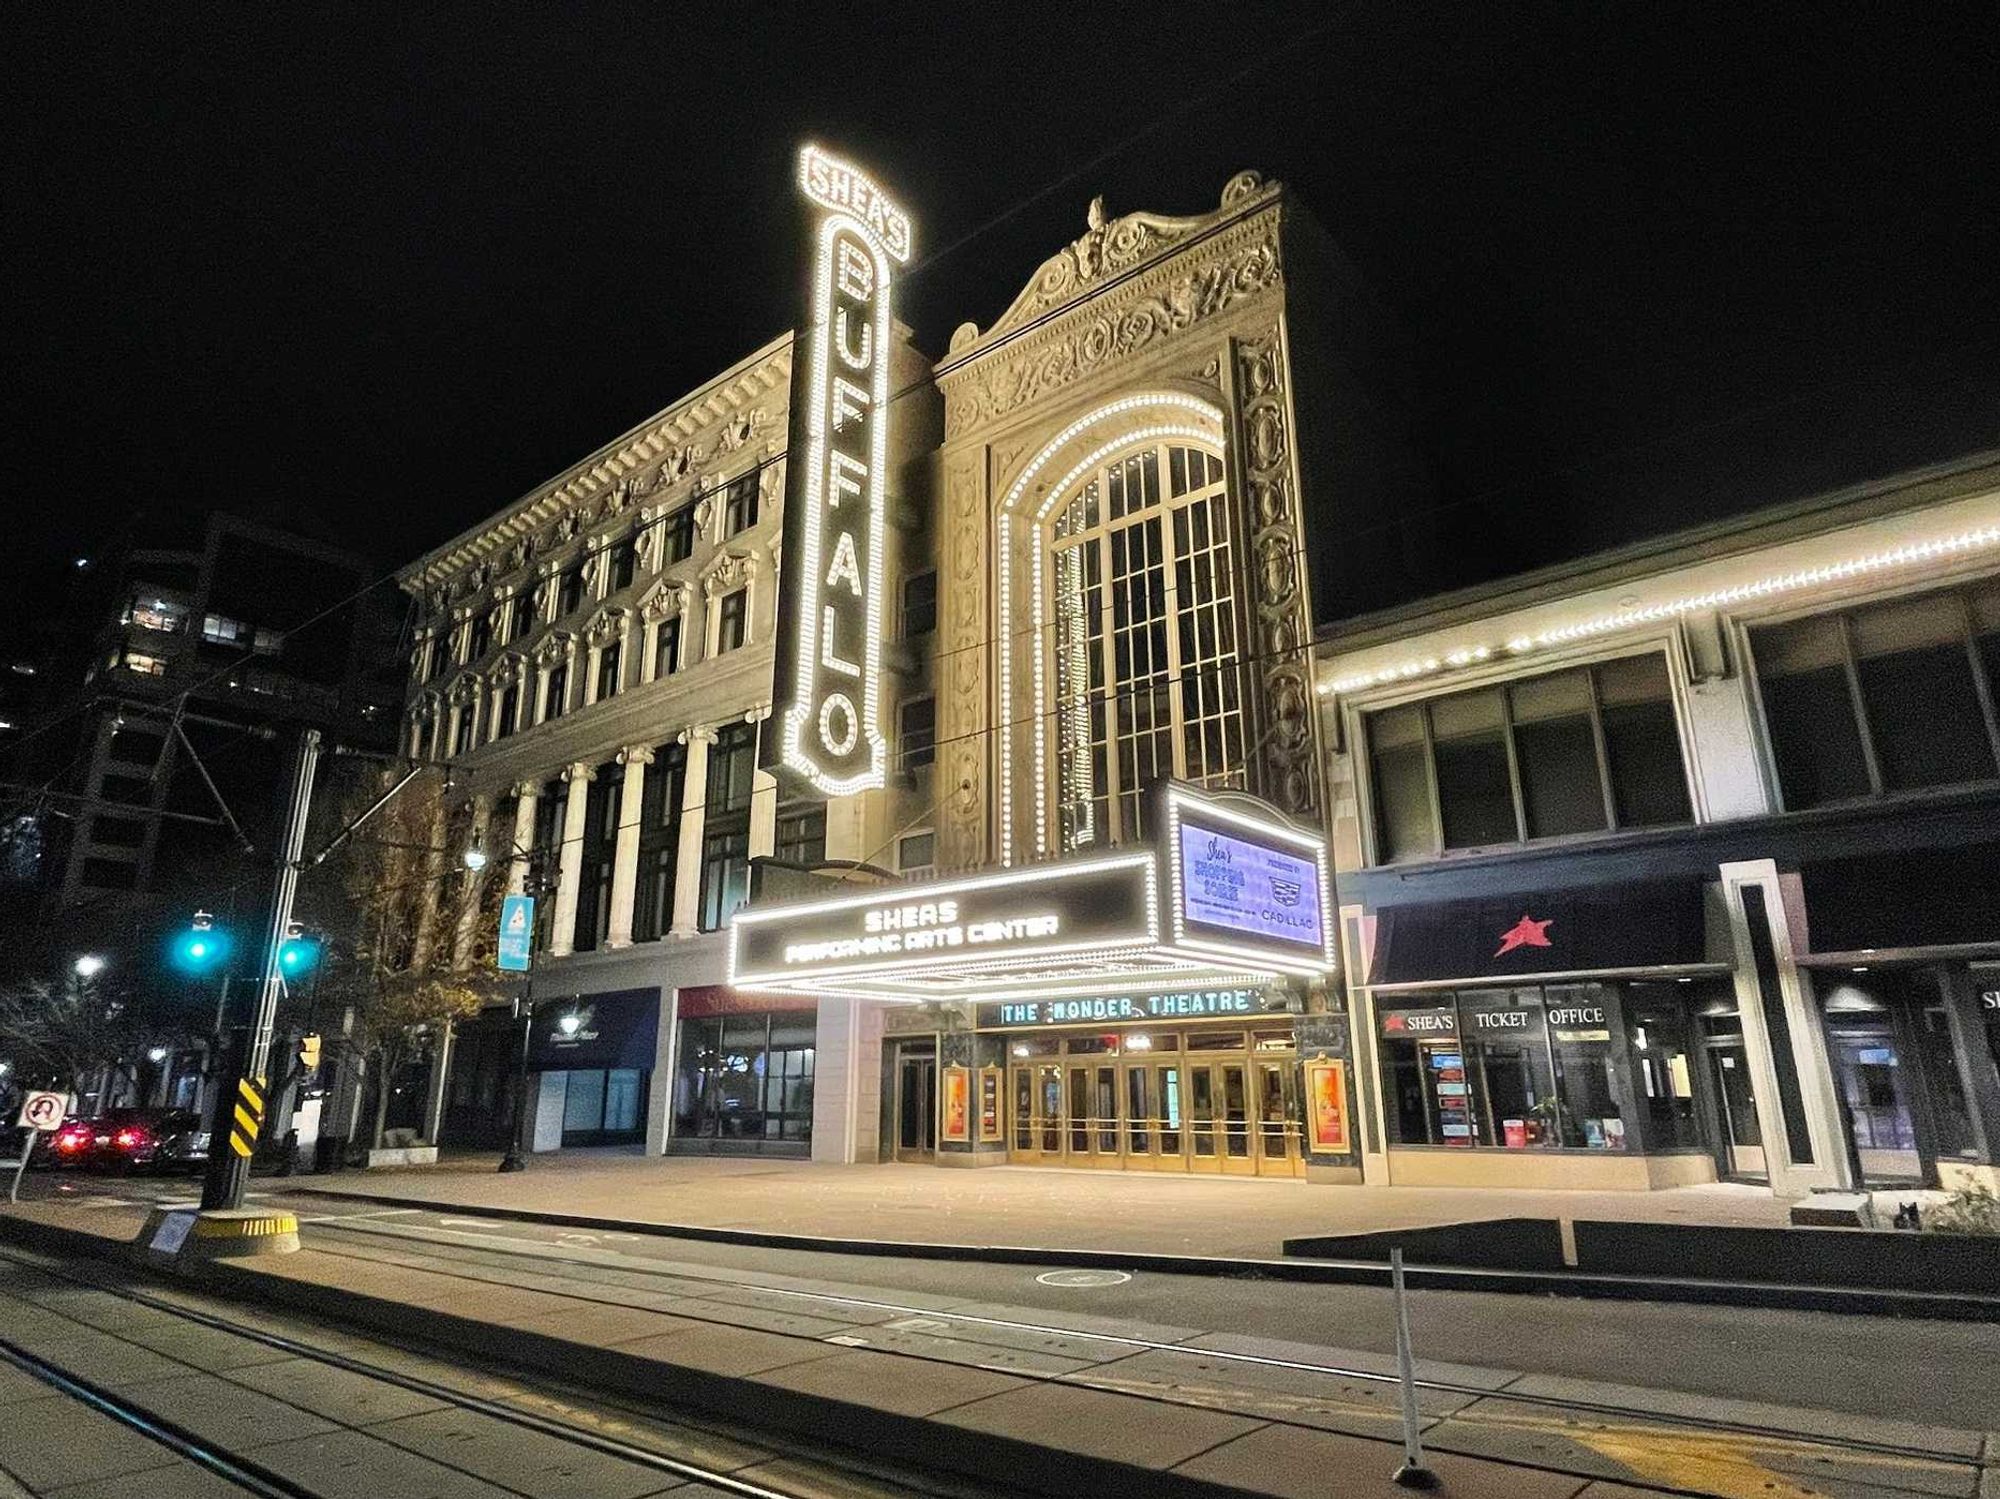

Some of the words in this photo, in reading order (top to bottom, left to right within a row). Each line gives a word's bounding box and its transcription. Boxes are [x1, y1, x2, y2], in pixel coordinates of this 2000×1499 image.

[819, 238, 875, 757] BUFFALO
[864, 901, 958, 932] SHEAS
[1261, 909, 1314, 930] CADILLAC
[904, 926, 964, 951] ARTS
[966, 915, 1059, 943] CENTER
[1004, 1003, 1038, 1022] THE
[1053, 998, 1132, 1020] WONDER
[1149, 991, 1250, 1015] THEATRE
[1407, 1014, 1454, 1031] SHEA'S
[1475, 1011, 1528, 1028] TICKET
[1549, 1007, 1605, 1025] OFFICE
